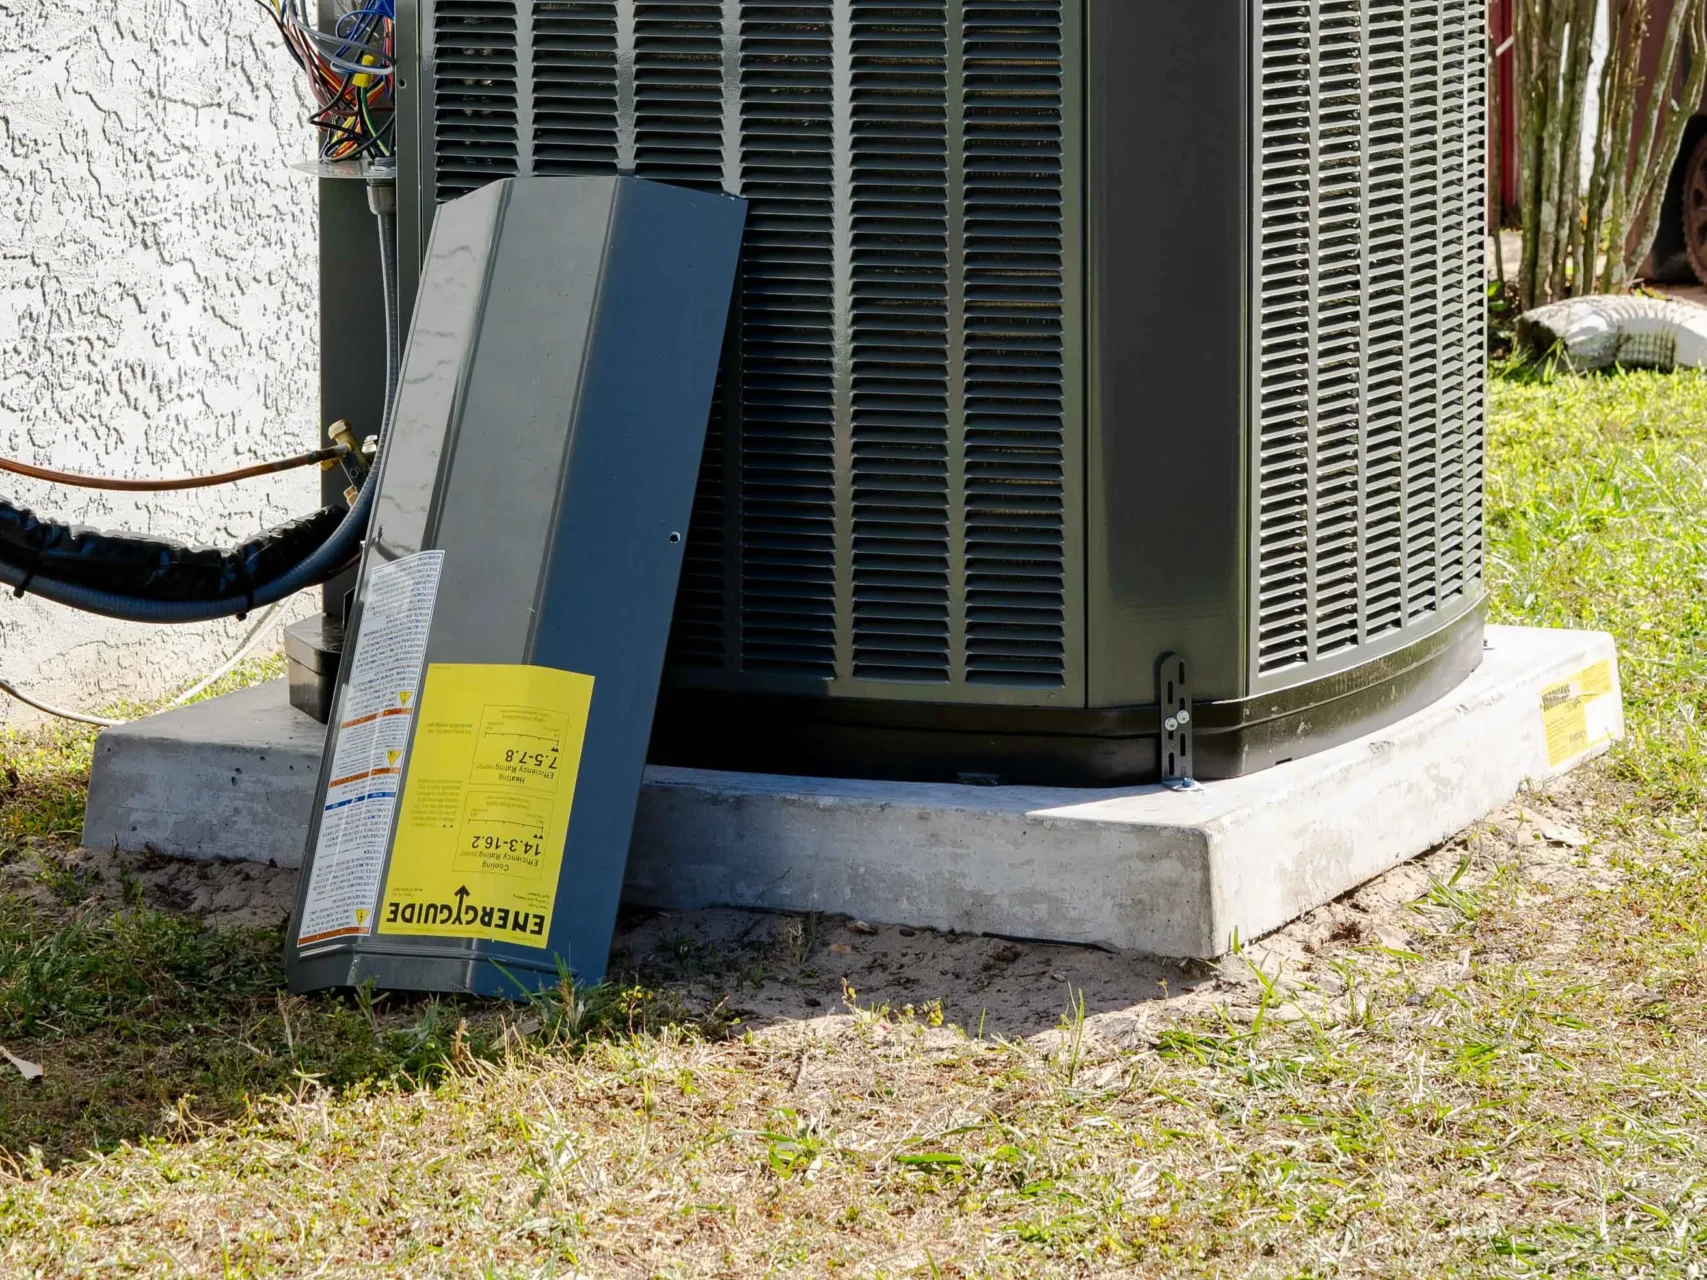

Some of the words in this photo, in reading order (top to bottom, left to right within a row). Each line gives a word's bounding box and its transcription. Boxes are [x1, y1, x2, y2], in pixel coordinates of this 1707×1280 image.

[505, 749, 557, 769] 7.5-7.8
[495, 763, 517, 773] Rating
[519, 766, 554, 780] Efficiency
[498, 774, 525, 784] Heating
[472, 835, 541, 856] 14.3-16.2
[479, 850, 501, 859] Rating
[503, 853, 539, 867] Efficiency
[482, 860, 509, 872] Cooling
[386, 902, 545, 935] ENERGYGUIDE
